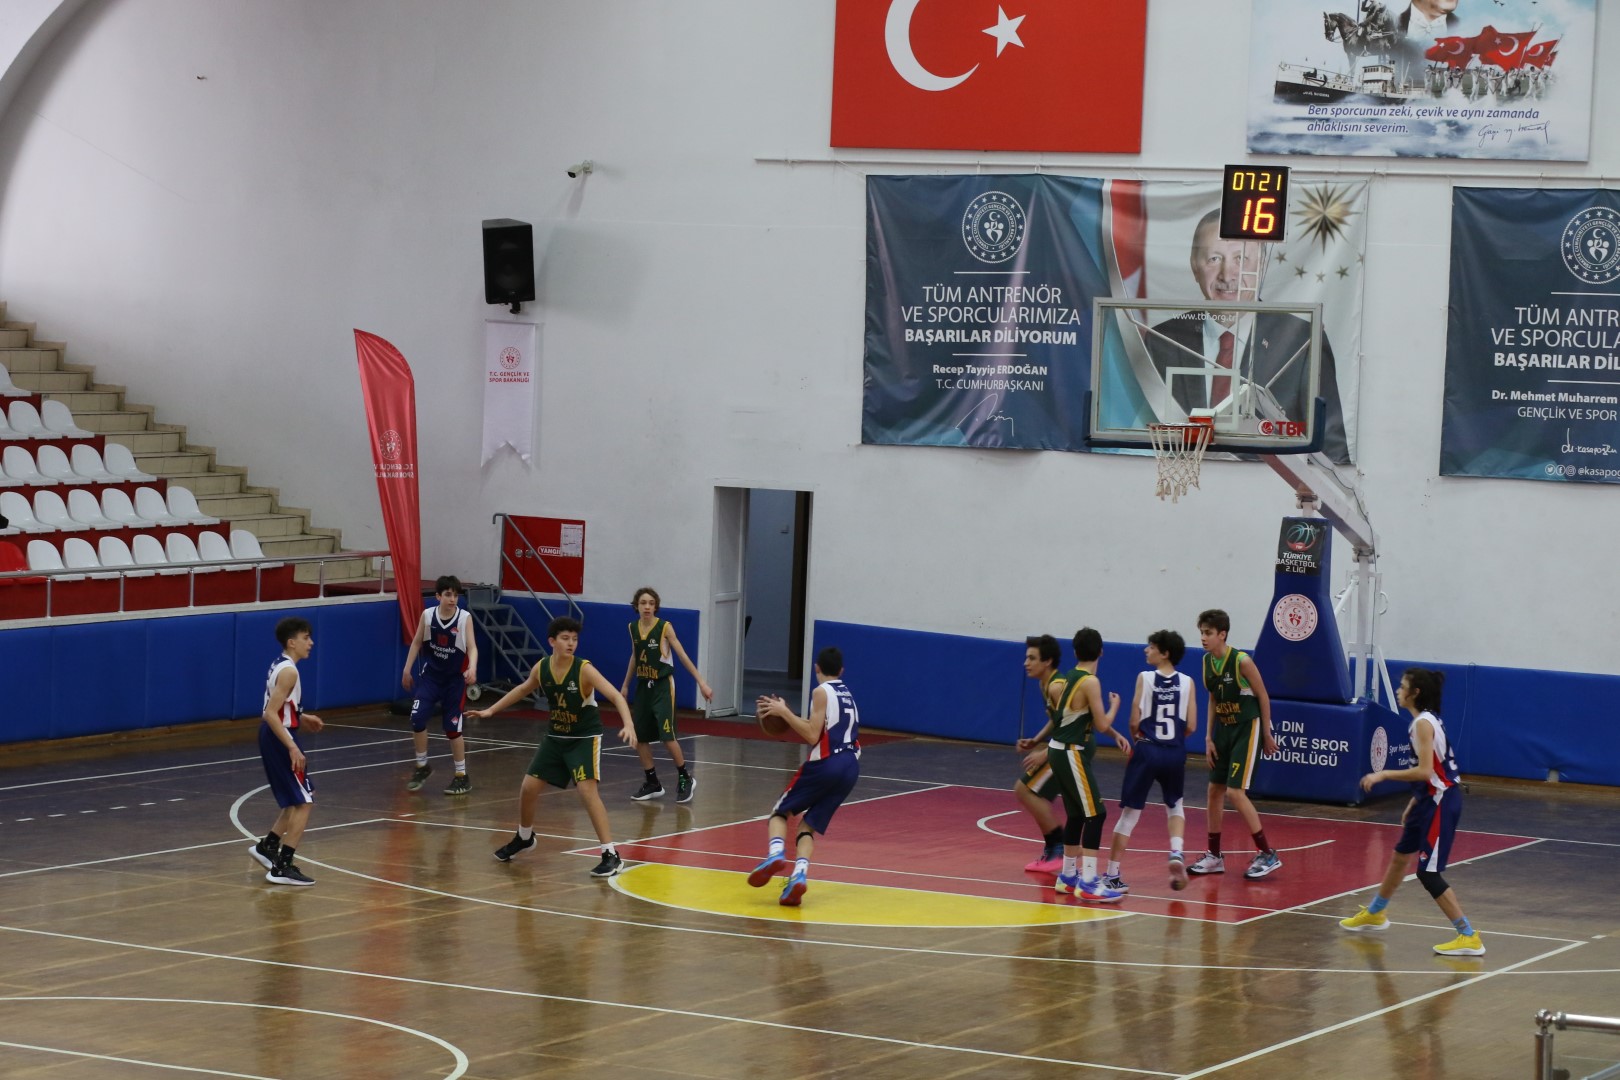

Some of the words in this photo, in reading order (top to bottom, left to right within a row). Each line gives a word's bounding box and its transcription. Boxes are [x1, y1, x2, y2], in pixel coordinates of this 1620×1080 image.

[1308, 105, 1328, 115] Ben
[1330, 107, 1387, 117] sporcunun
[1389, 106, 1413, 118] zeki,
[1416, 106, 1444, 119] çevik
[1446, 109, 1459, 117] ve
[1461, 109, 1484, 120] aynı
[1487, 108, 1540, 119] zamanda
[1307, 121, 1362, 132] ahlaklısını
[1364, 123, 1409, 133] severim.
[1242, 198, 1275, 233] 16
[922, 283, 962, 303] TÜM
[966, 284, 1062, 304] ANTRENÖR
[901, 306, 923, 322] VE
[927, 306, 1081, 325] SPORCULARIMIZA
[1515, 304, 1560, 326] TÜM
[905, 329, 991, 346] BAŞARILAR
[994, 327, 1077, 345] DİLİYORUM
[1491, 328, 1515, 346] VE
[1494, 352, 1591, 371] BAŞARILAR
[933, 364, 964, 376] Recep
[965, 365, 996, 377] Tayyip
[996, 364, 1048, 376] ERDOĞAN
[935, 379, 955, 389] T.C.
[956, 379, 1044, 393] CUMHURBAŞKANI
[1491, 390, 1508, 400] Dr.
[1510, 391, 1556, 402] Mehmet
[1558, 392, 1618, 404] Muharrem
[1517, 406, 1566, 421] GENÇLİK
[1568, 408, 1583, 420] VE
[1585, 409, 1618, 421] SPOR
[1275, 421, 1307, 437] TBF
[1276, 558, 1317, 569] BASKETBOL
[640, 649, 648, 663] 4
[554, 692, 567, 708] 14
[663, 718, 671, 733] 4
[842, 708, 855, 744] 7
[1155, 703, 1176, 740] 5
[1290, 736, 1307, 748] VE
[572, 764, 587, 781] 14
[1231, 762, 1241, 778] 7
